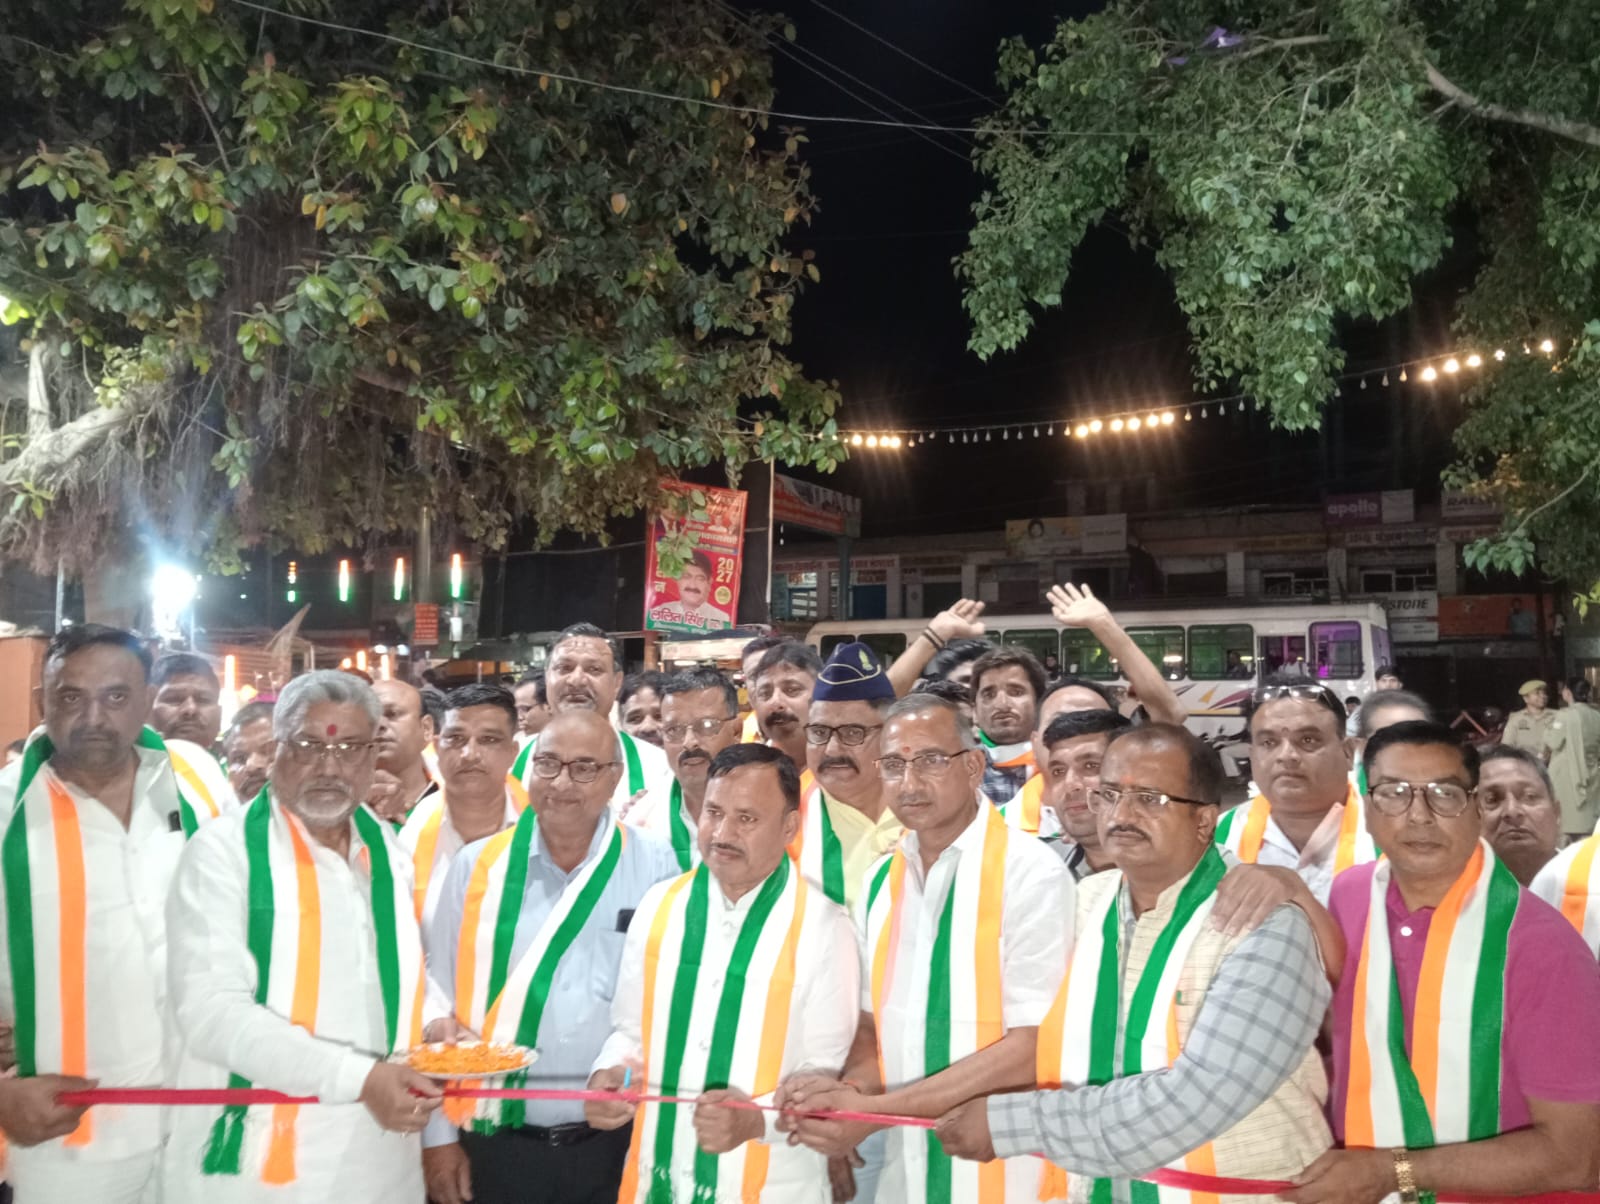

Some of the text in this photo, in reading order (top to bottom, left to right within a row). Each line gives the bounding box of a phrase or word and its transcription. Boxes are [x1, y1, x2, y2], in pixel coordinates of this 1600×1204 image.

[1327, 499, 1378, 518] apollo
[718, 557, 734, 571] 20
[716, 570, 733, 583] 27
[651, 607, 682, 623] ललित
